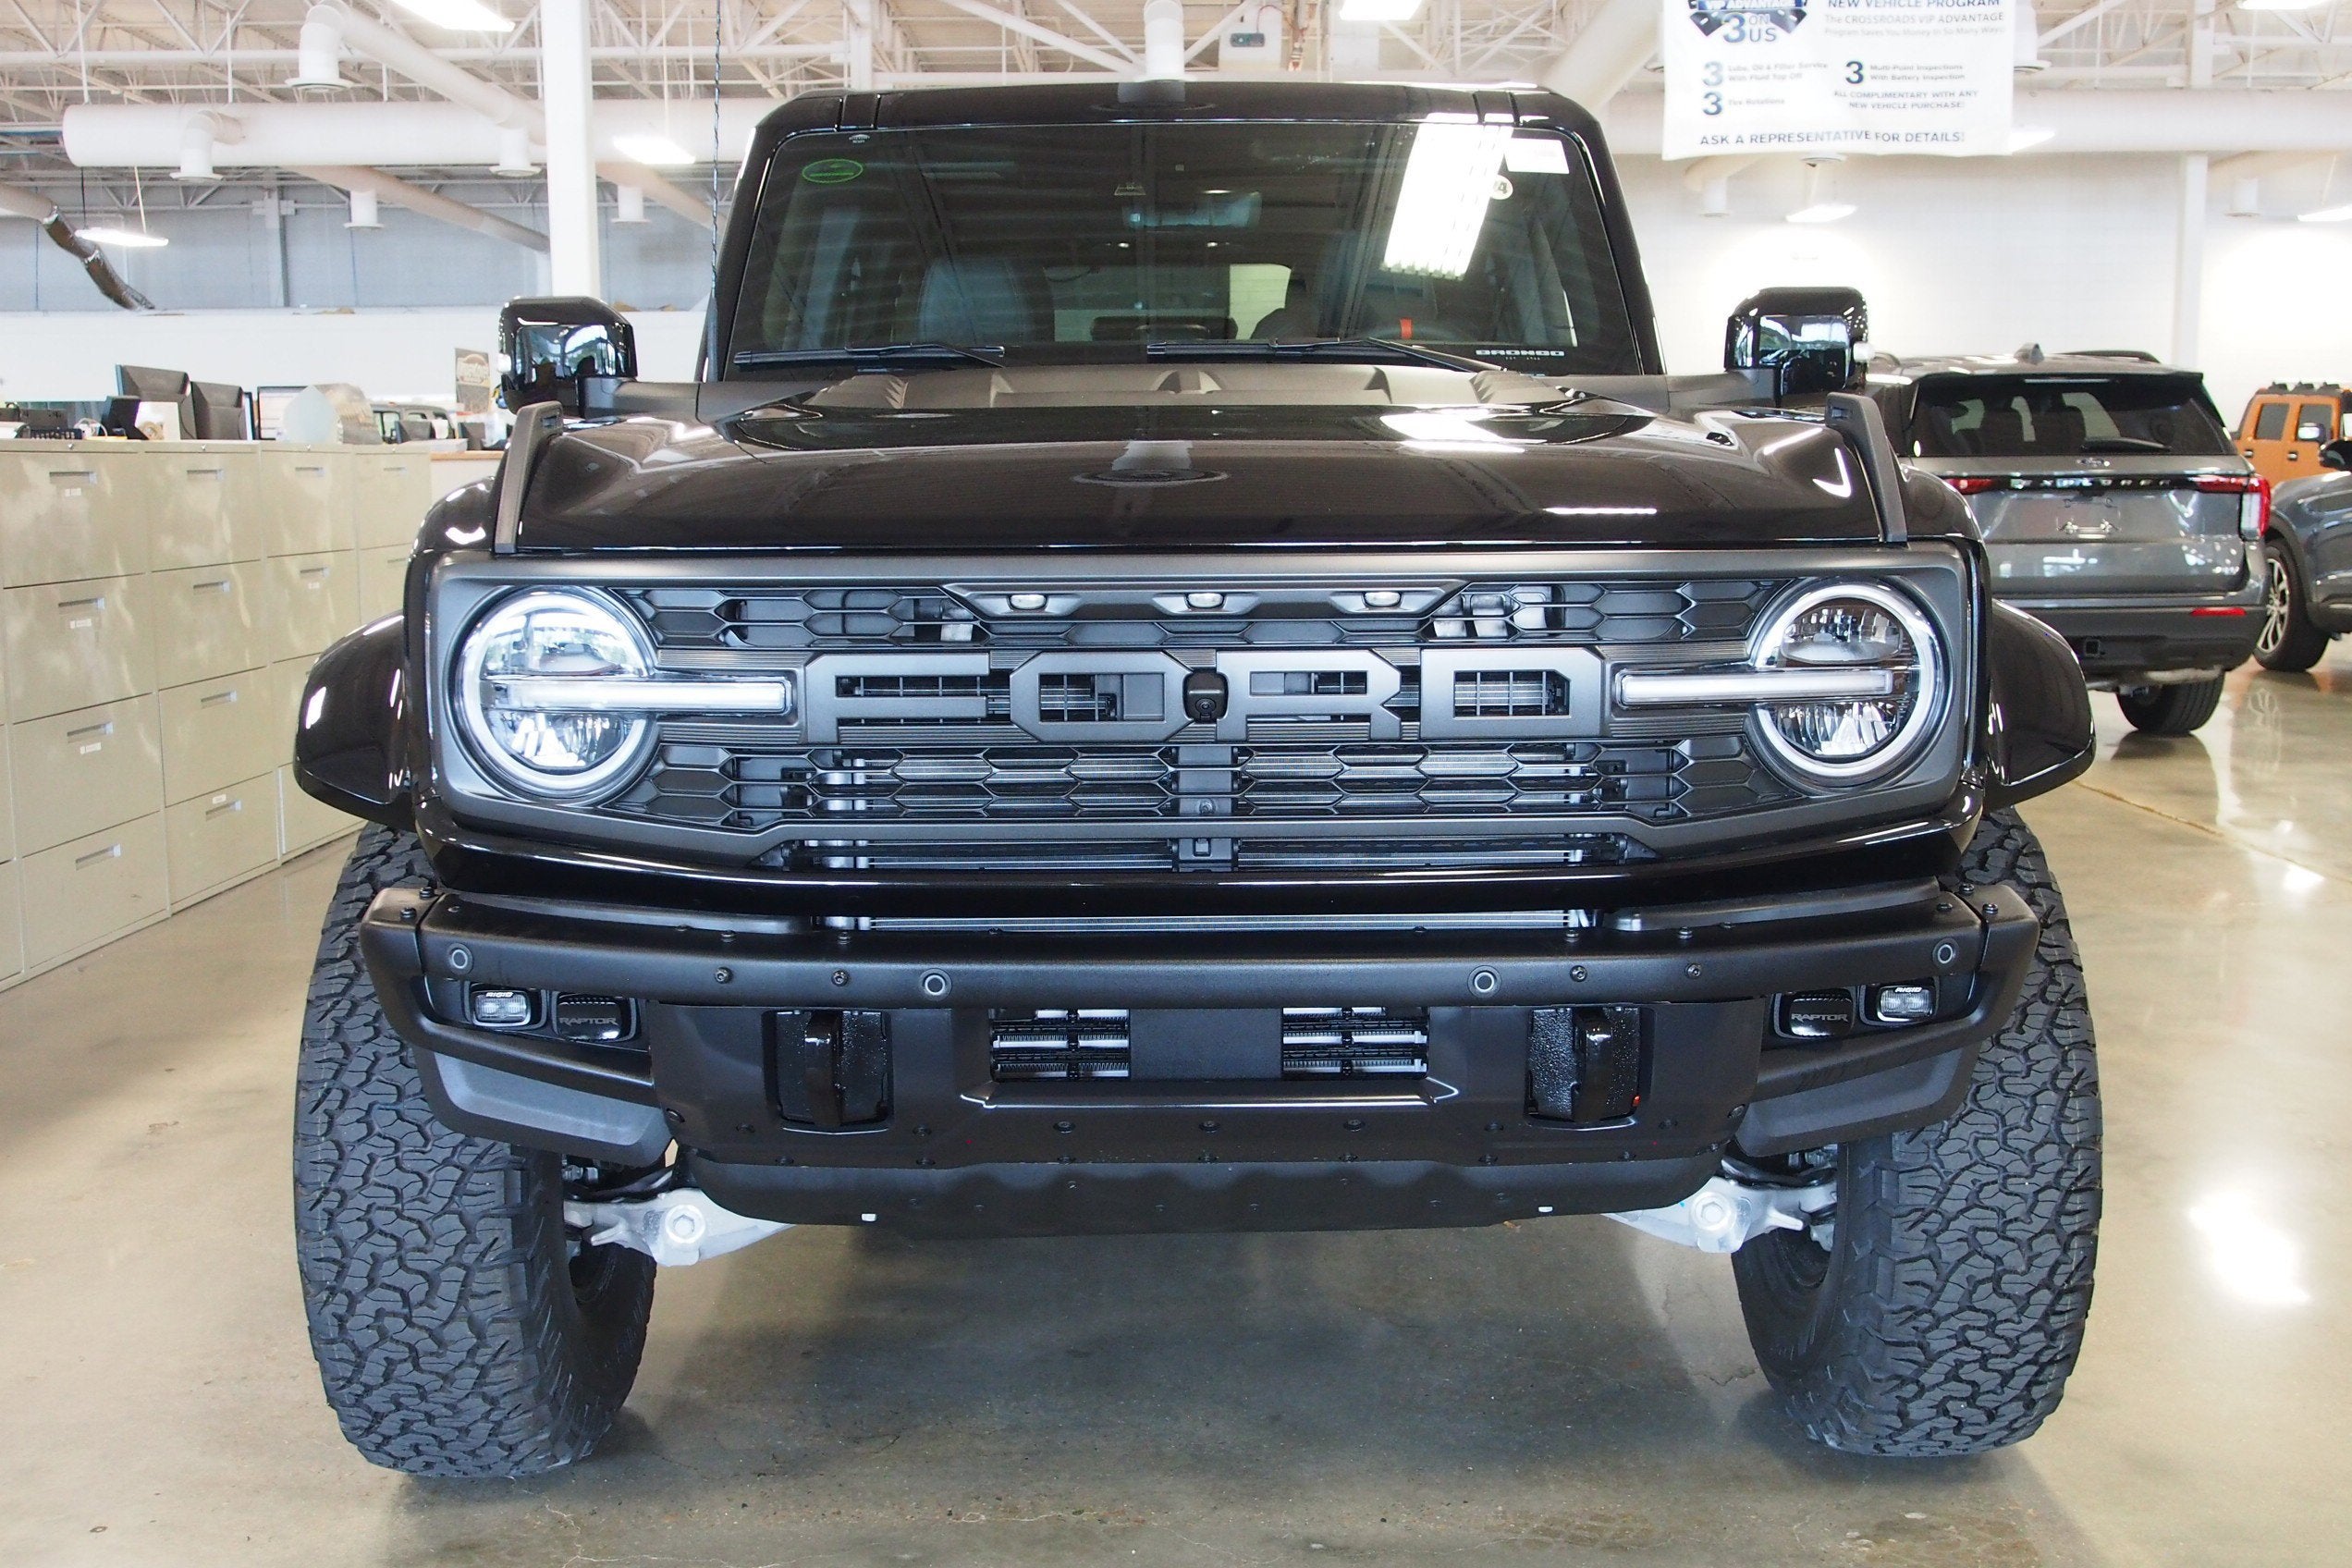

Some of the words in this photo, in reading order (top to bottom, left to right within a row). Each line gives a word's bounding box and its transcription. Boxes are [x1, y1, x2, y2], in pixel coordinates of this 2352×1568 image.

[1866, 0, 1922, 8] VEHICLE
[1748, 14, 1770, 26] ON
[1844, 15, 1916, 24] CROSSROADS
[1938, 11, 2004, 23] ADVANTAGE
[1722, 12, 1746, 43] 3
[1749, 28, 1777, 43] US
[1702, 61, 1723, 87] 3
[1845, 60, 1865, 85] 3
[1850, 90, 1928, 99] COMPLIMENTARY
[1932, 90, 1955, 98] WITH
[1958, 90, 1978, 98] ANY
[1702, 91, 1723, 116] 3
[1700, 134, 1729, 145] ASK
[1734, 134, 1745, 144] A
[1750, 129, 1870, 144] REPRESENTATIVE
[1875, 132, 1900, 143] FOR
[807, 646, 1604, 744] FORD
[558, 1017, 619, 1026] RAPTOR
[1791, 1013, 1848, 1023] RAPTOR
